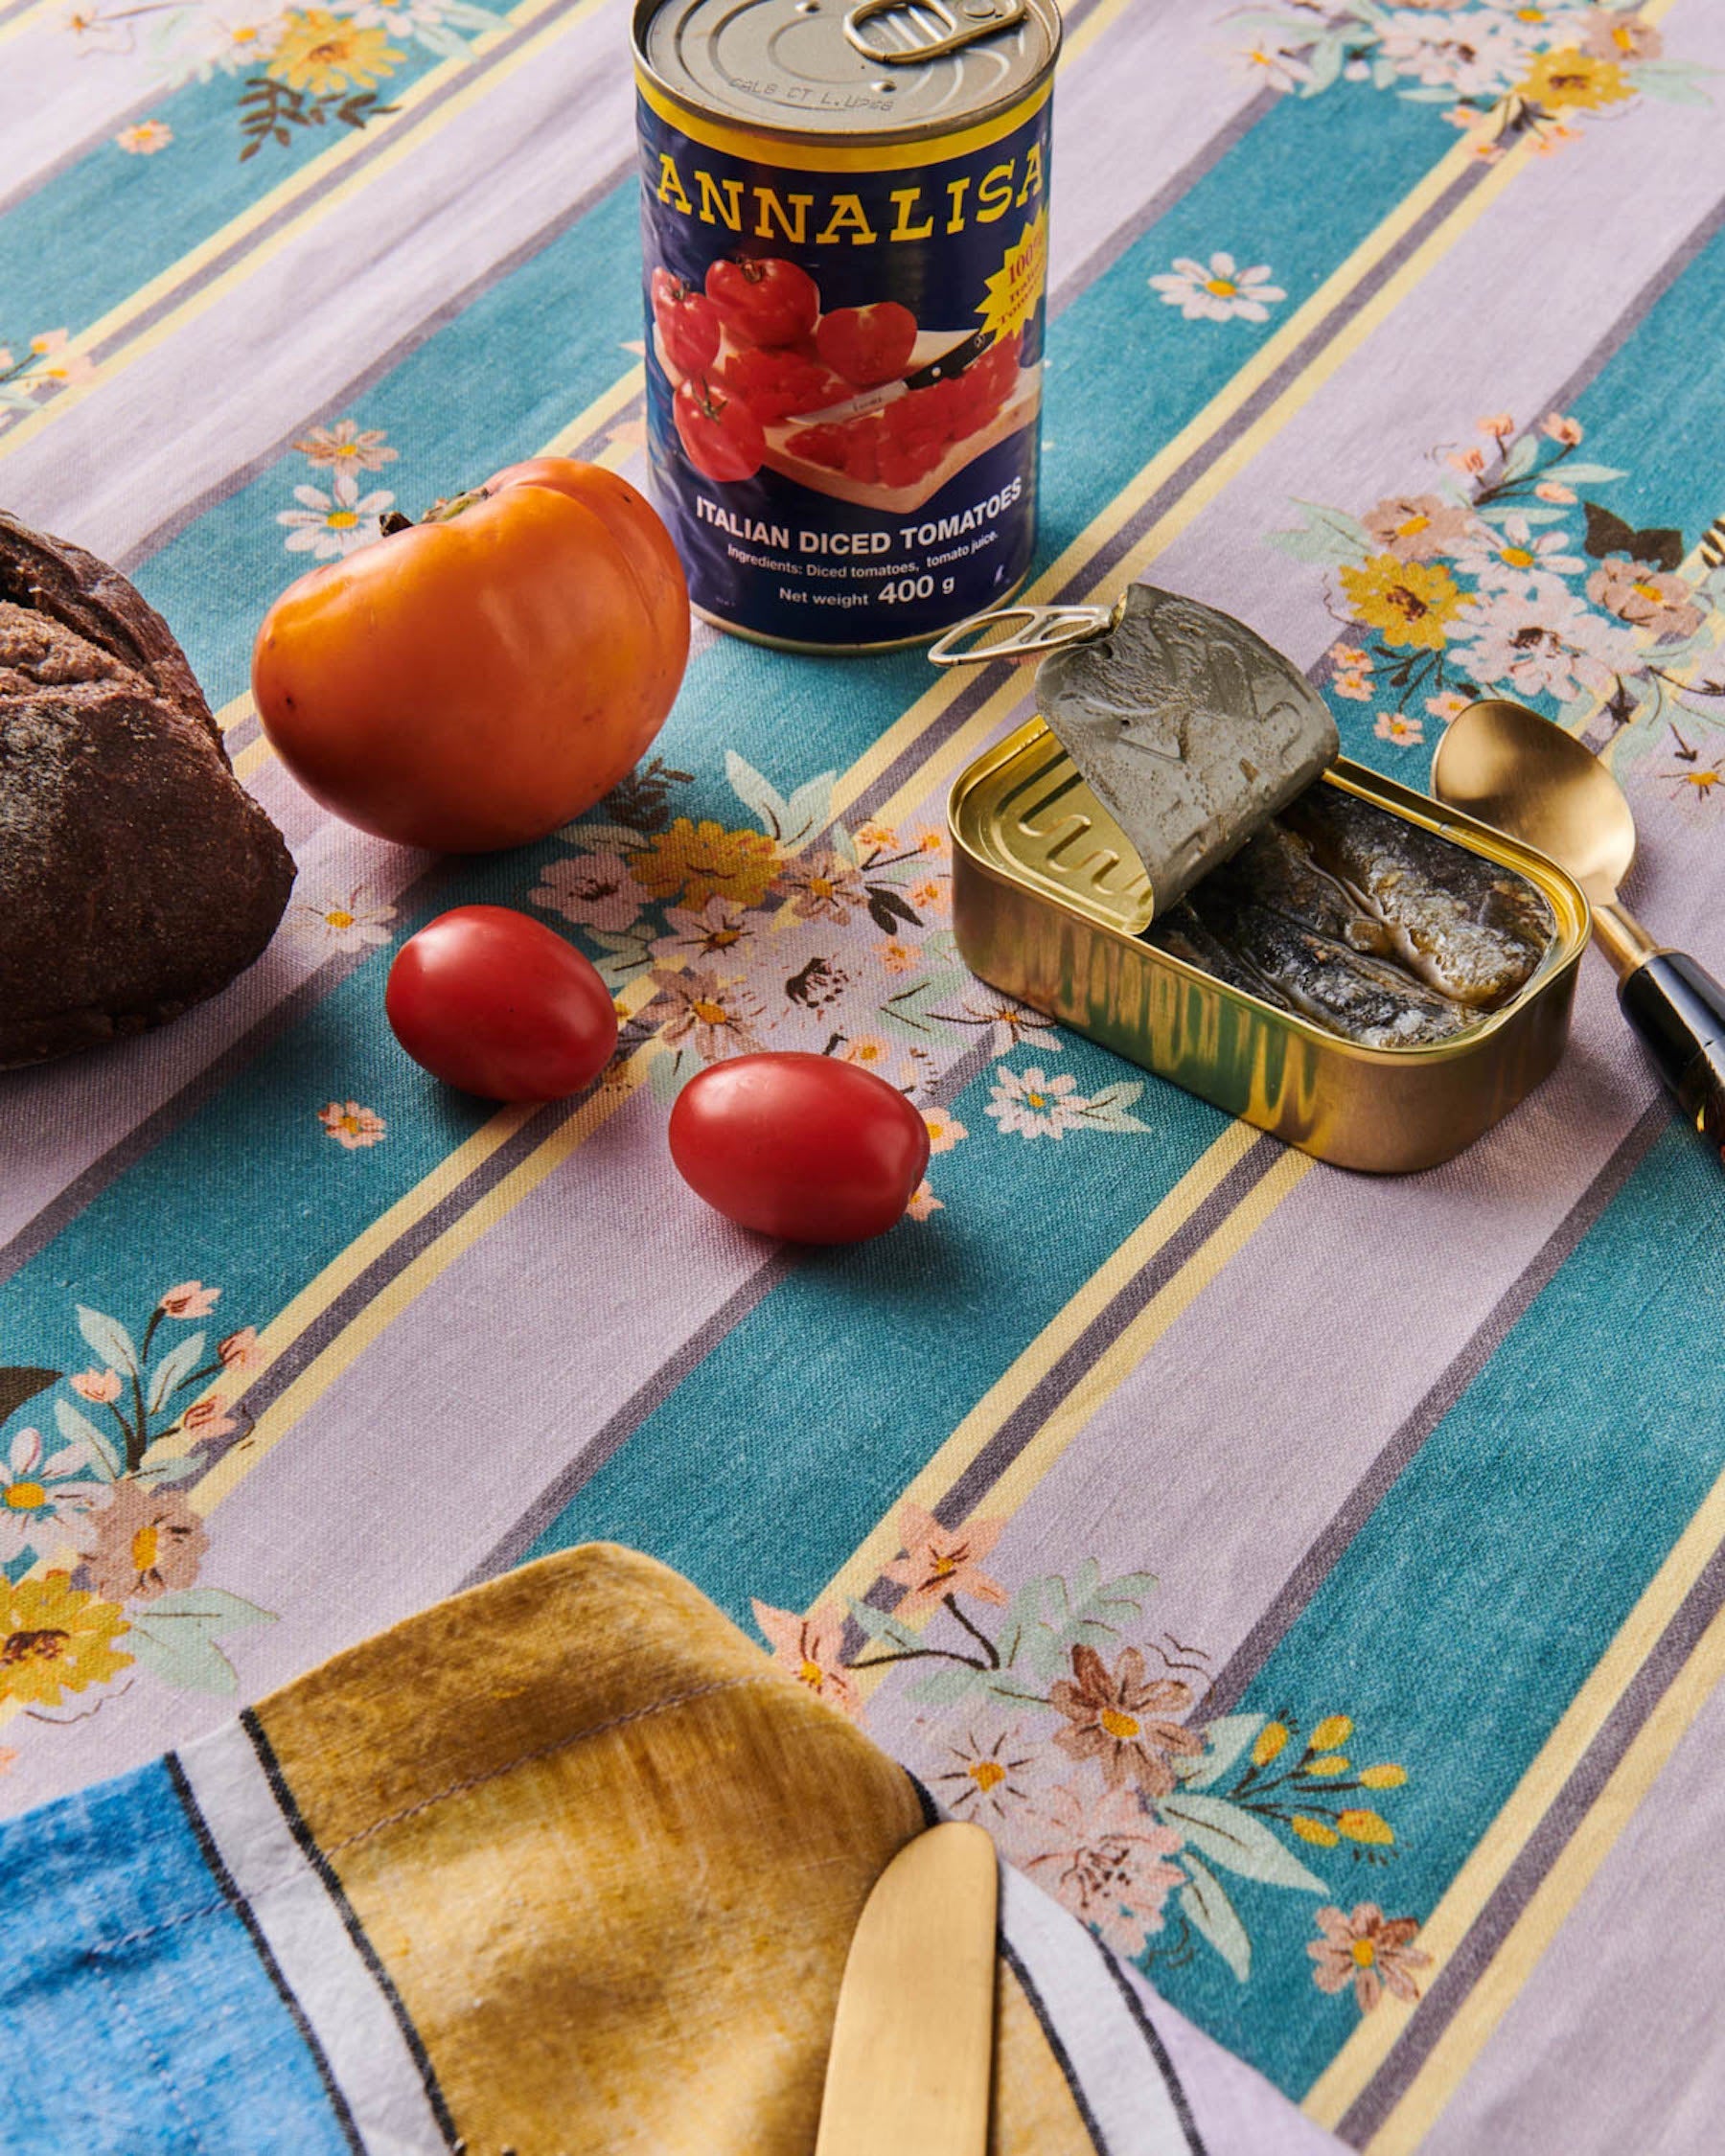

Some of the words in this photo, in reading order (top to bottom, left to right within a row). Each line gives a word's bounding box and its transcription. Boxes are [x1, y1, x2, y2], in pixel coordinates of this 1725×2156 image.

[656, 145, 1044, 245] ANNALISA
[696, 495, 790, 549] ITALIAN
[799, 531, 892, 556] DICED
[899, 475, 1023, 550] TOMATOES
[727, 543, 803, 575] Ingredients:
[806, 563, 847, 578] Diced
[851, 562, 920, 578] tomatoes,
[927, 544, 970, 568] tomato
[970, 530, 999, 555] juice.
[779, 586, 808, 603] Net
[812, 593, 869, 608] weight
[878, 575, 934, 605] 400
[941, 576, 955, 595] g
